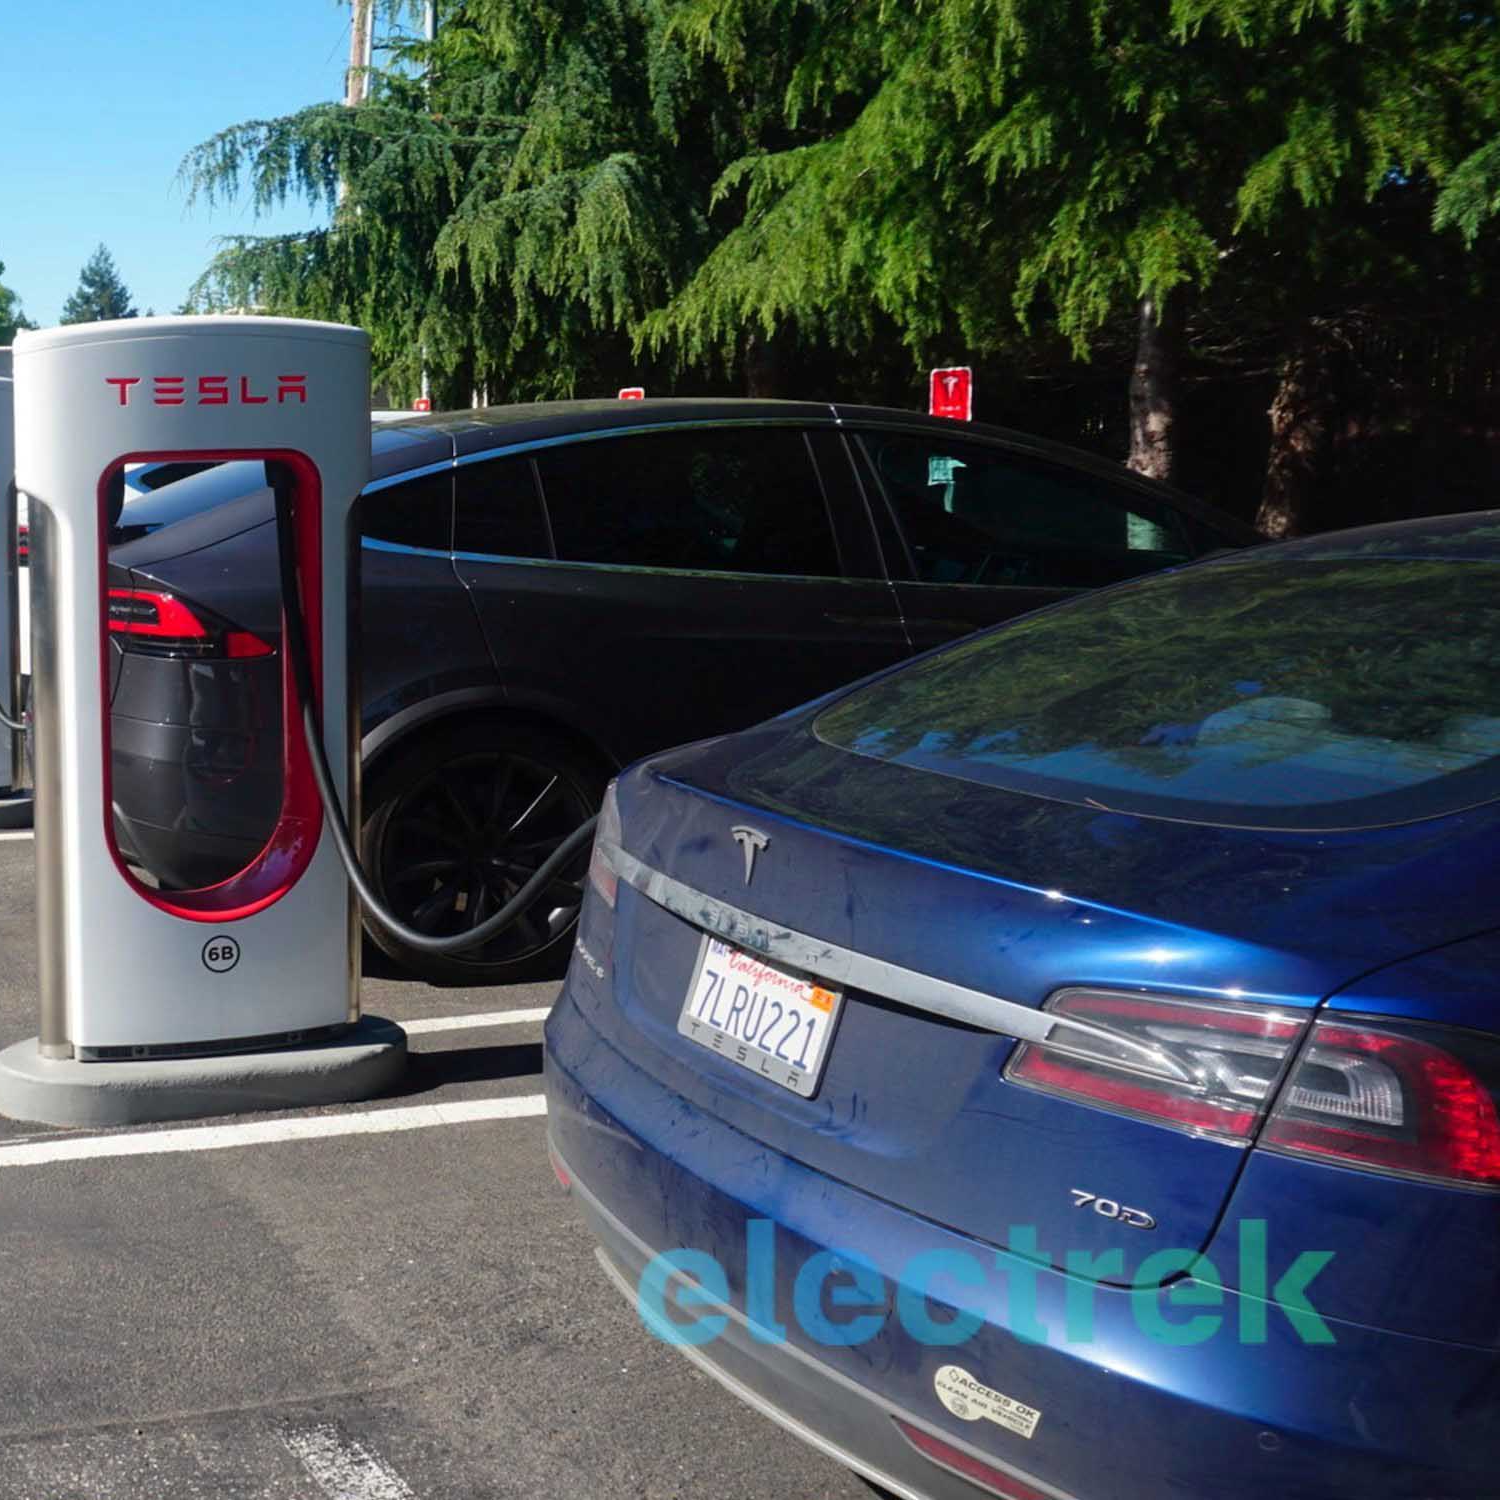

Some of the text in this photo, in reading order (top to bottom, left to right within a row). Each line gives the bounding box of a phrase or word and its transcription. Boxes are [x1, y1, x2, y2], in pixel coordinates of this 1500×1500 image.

[105, 376, 307, 405] TESLA
[209, 946, 234, 962] 6B
[727, 950, 809, 1001] California
[698, 970, 816, 1070] 7LRU221
[691, 1022, 800, 1088] TESLA
[1071, 1188, 1156, 1230] 70D
[959, 1378, 1012, 1407] ACCESS
[1015, 1404, 1037, 1419] OK
